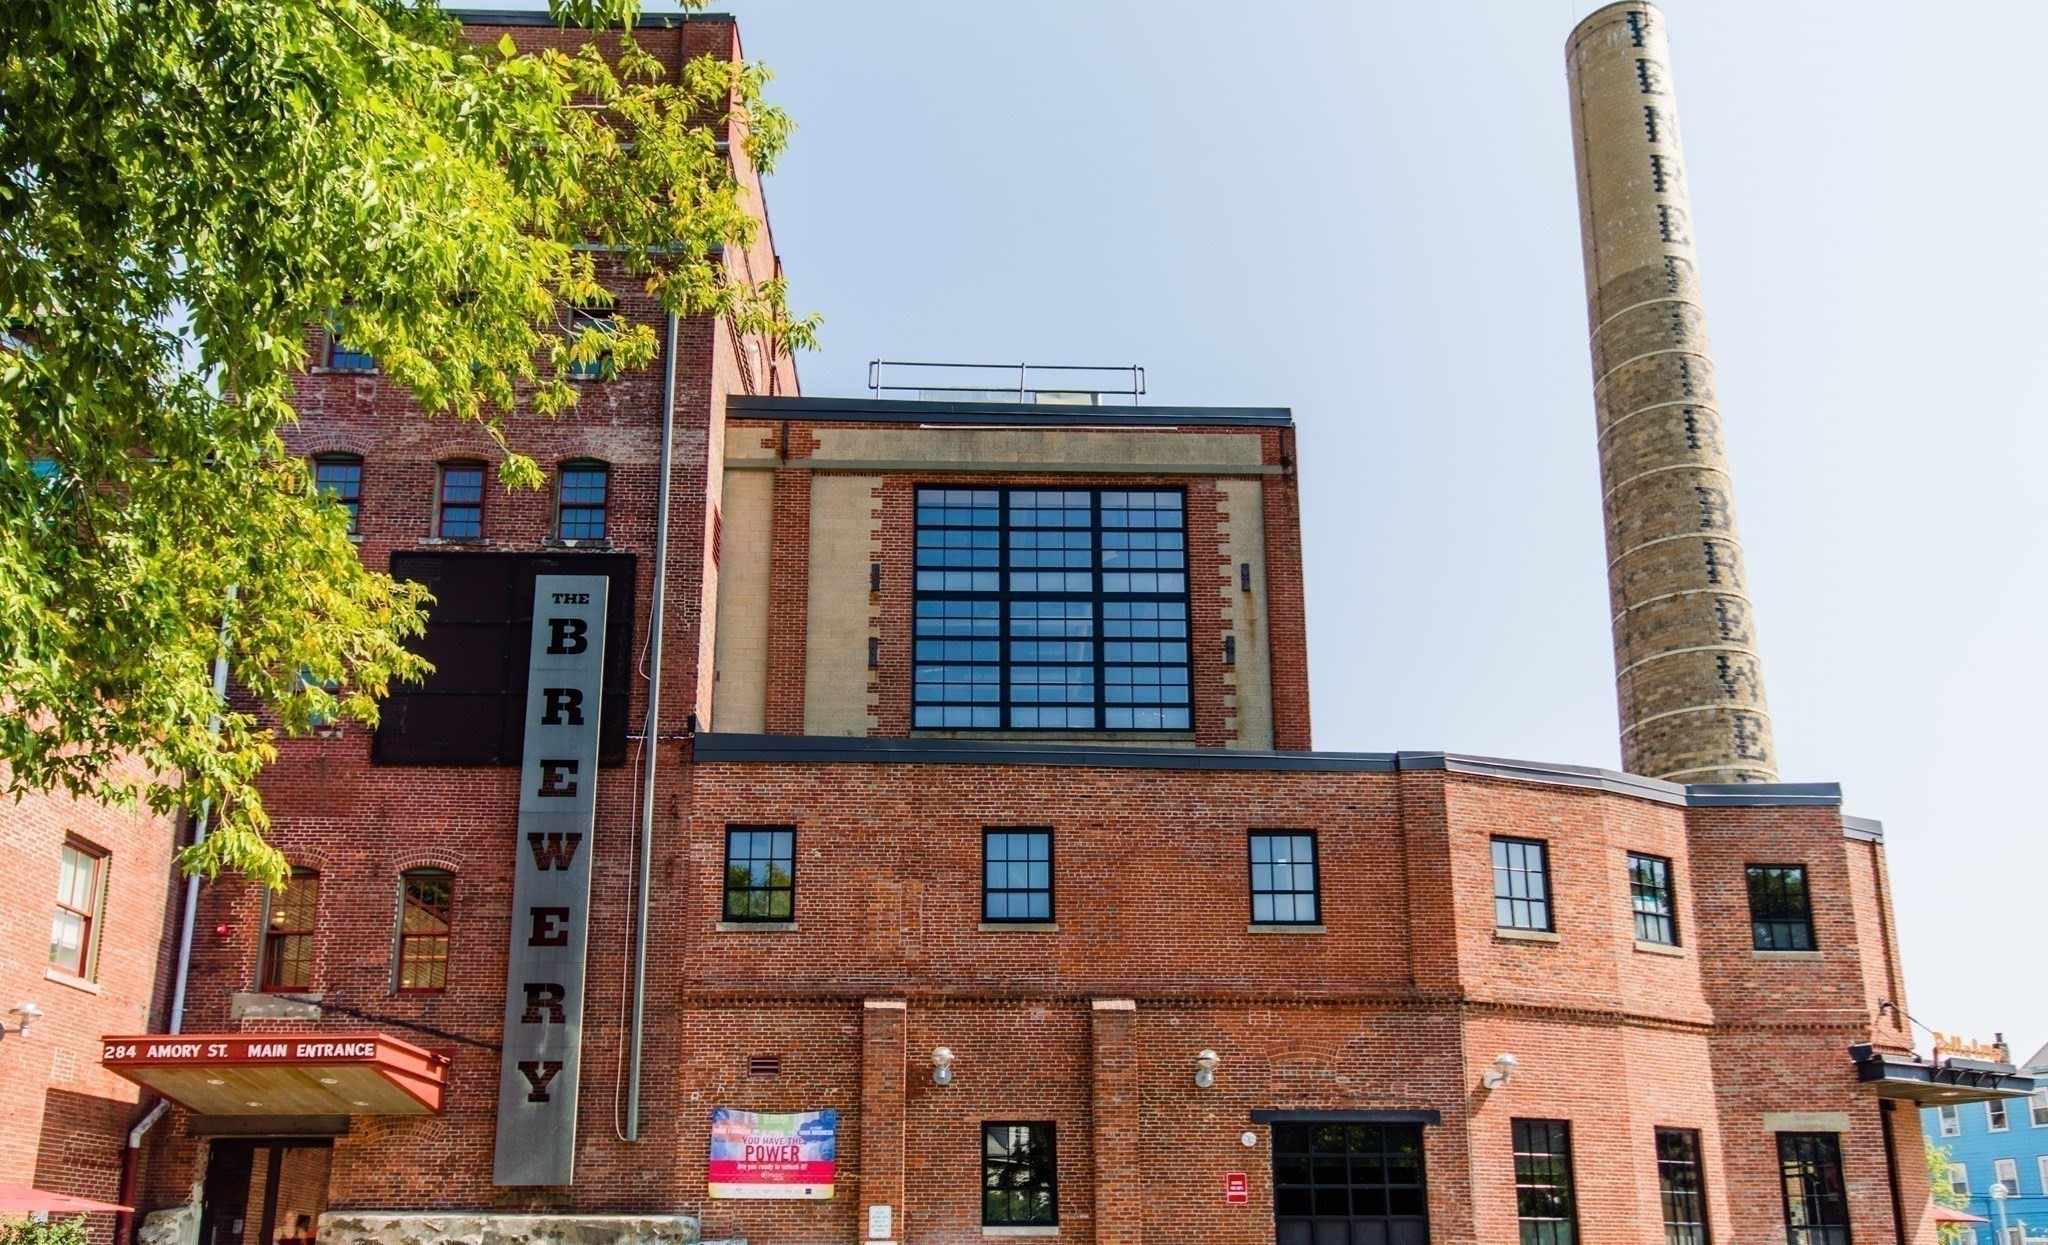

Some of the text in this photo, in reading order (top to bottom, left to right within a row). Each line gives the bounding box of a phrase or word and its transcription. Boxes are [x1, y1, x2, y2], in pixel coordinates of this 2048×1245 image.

[552, 593, 590, 605] THE
[517, 618, 590, 1103] BREWERY
[103, 1042, 375, 1059] 284 AMORY ST. MAIN ENTRANCE
[743, 1137, 804, 1145] YOU HAVE THE
[745, 1145, 800, 1162] POWER
[758, 1163, 774, 1171] ready
[800, 1163, 808, 1171] it?
